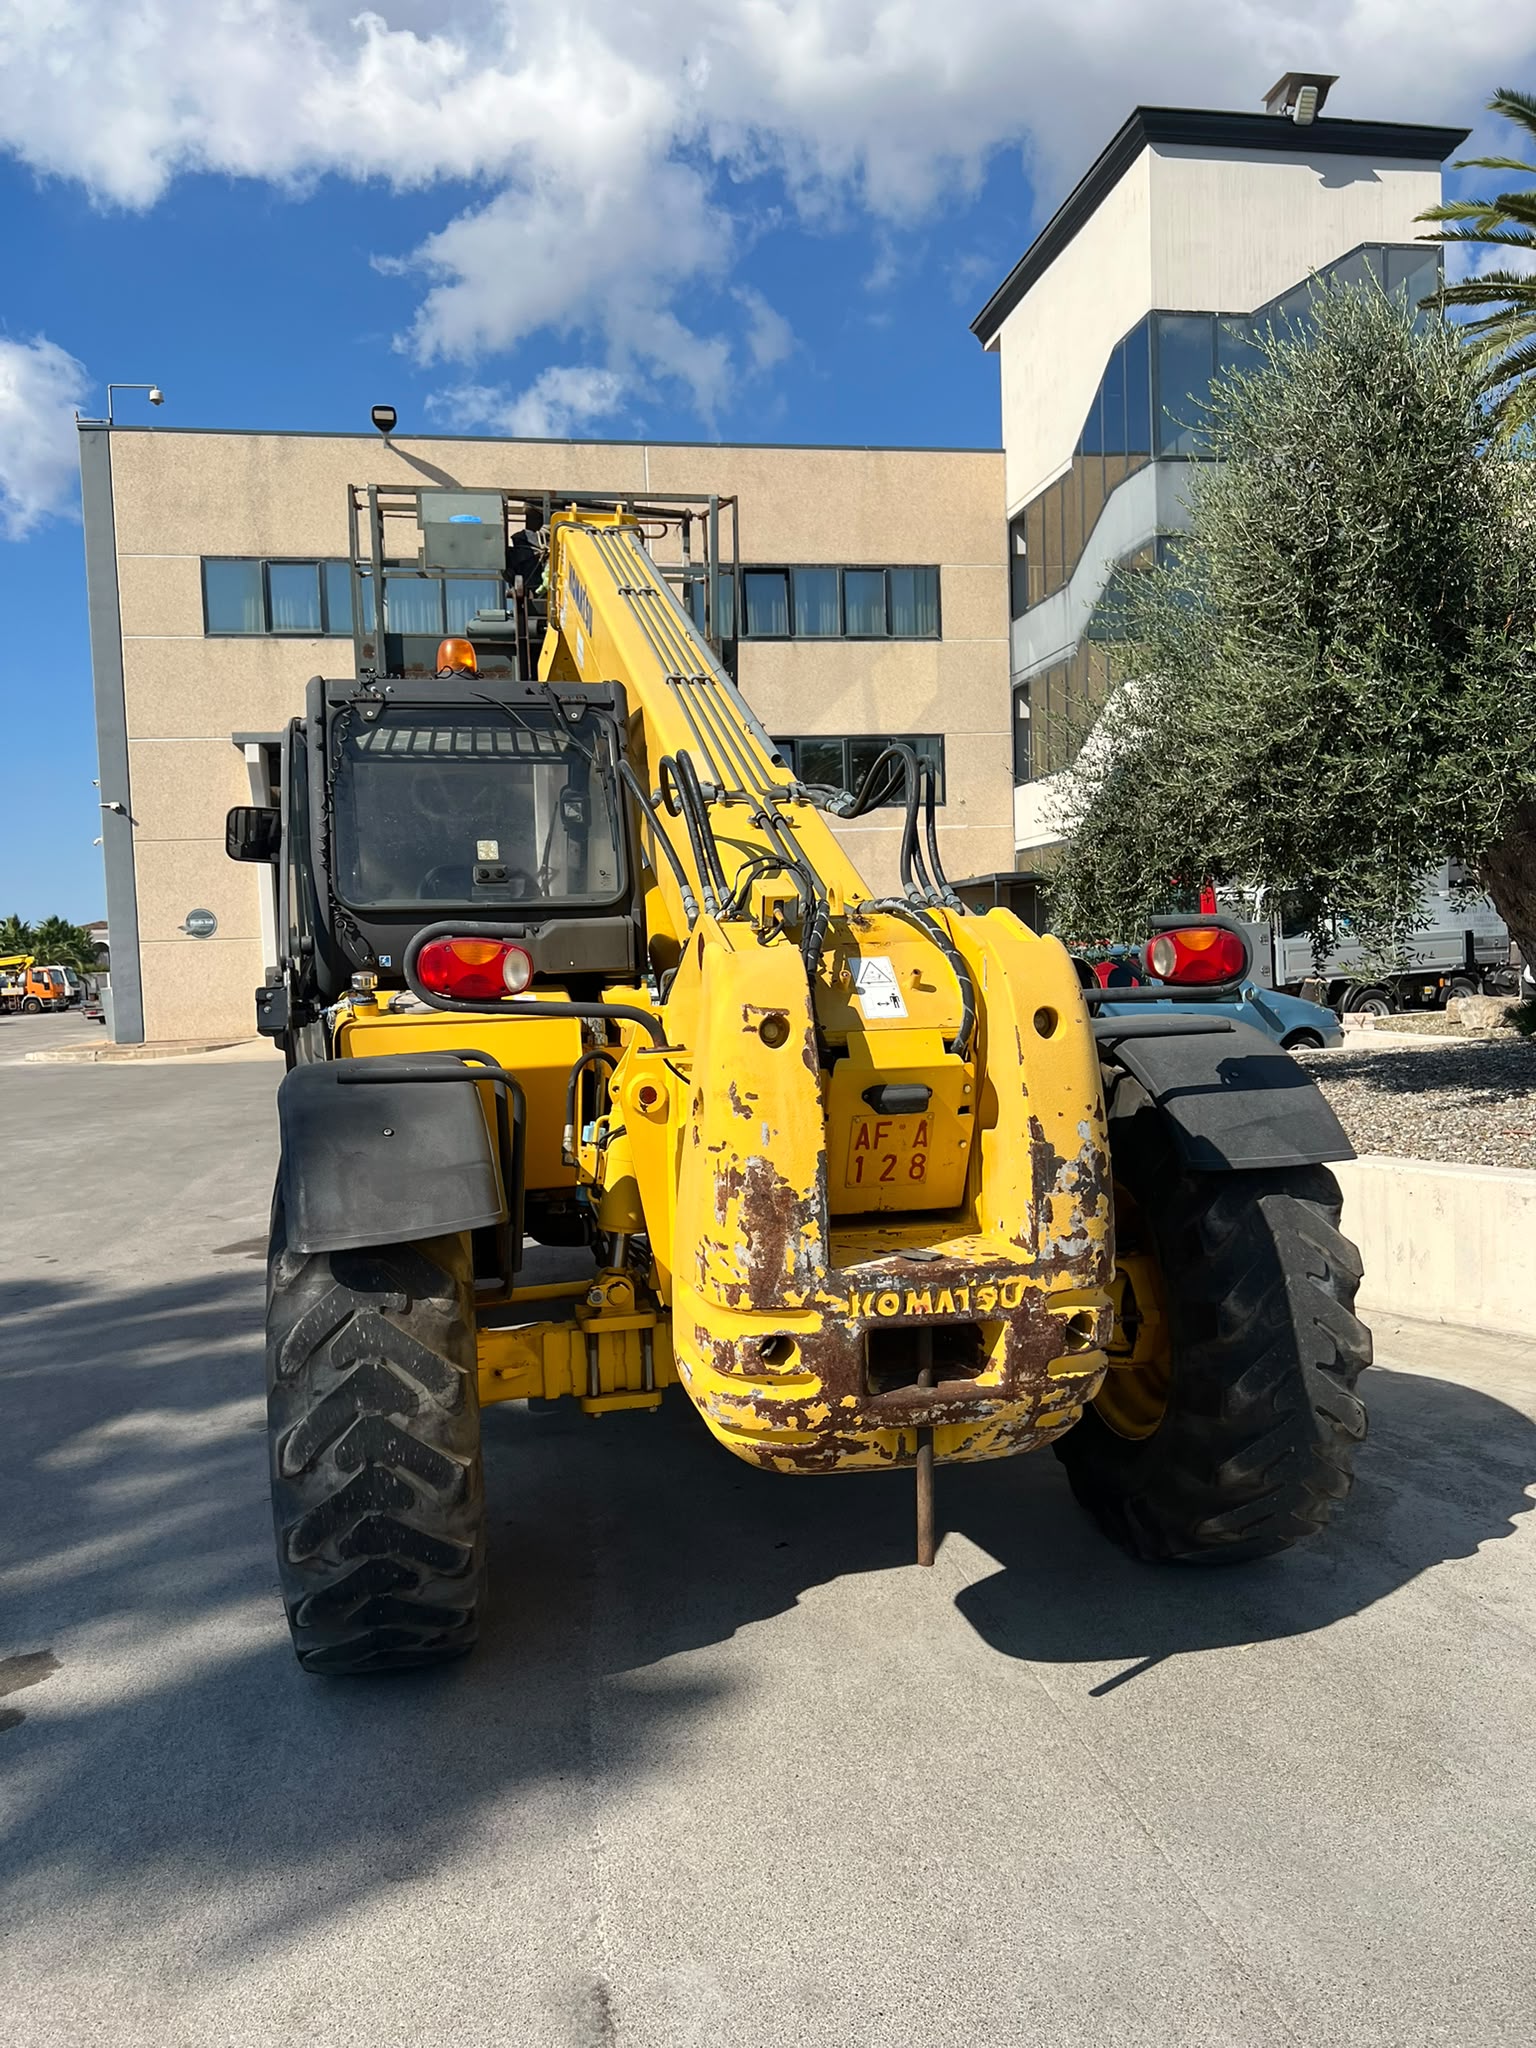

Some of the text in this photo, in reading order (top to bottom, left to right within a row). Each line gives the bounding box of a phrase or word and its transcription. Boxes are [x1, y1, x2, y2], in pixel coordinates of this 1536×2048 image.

[854, 1121, 893, 1151] AF
[855, 1152, 927, 1183] 128
[849, 1281, 1027, 1319] KOMATSU
